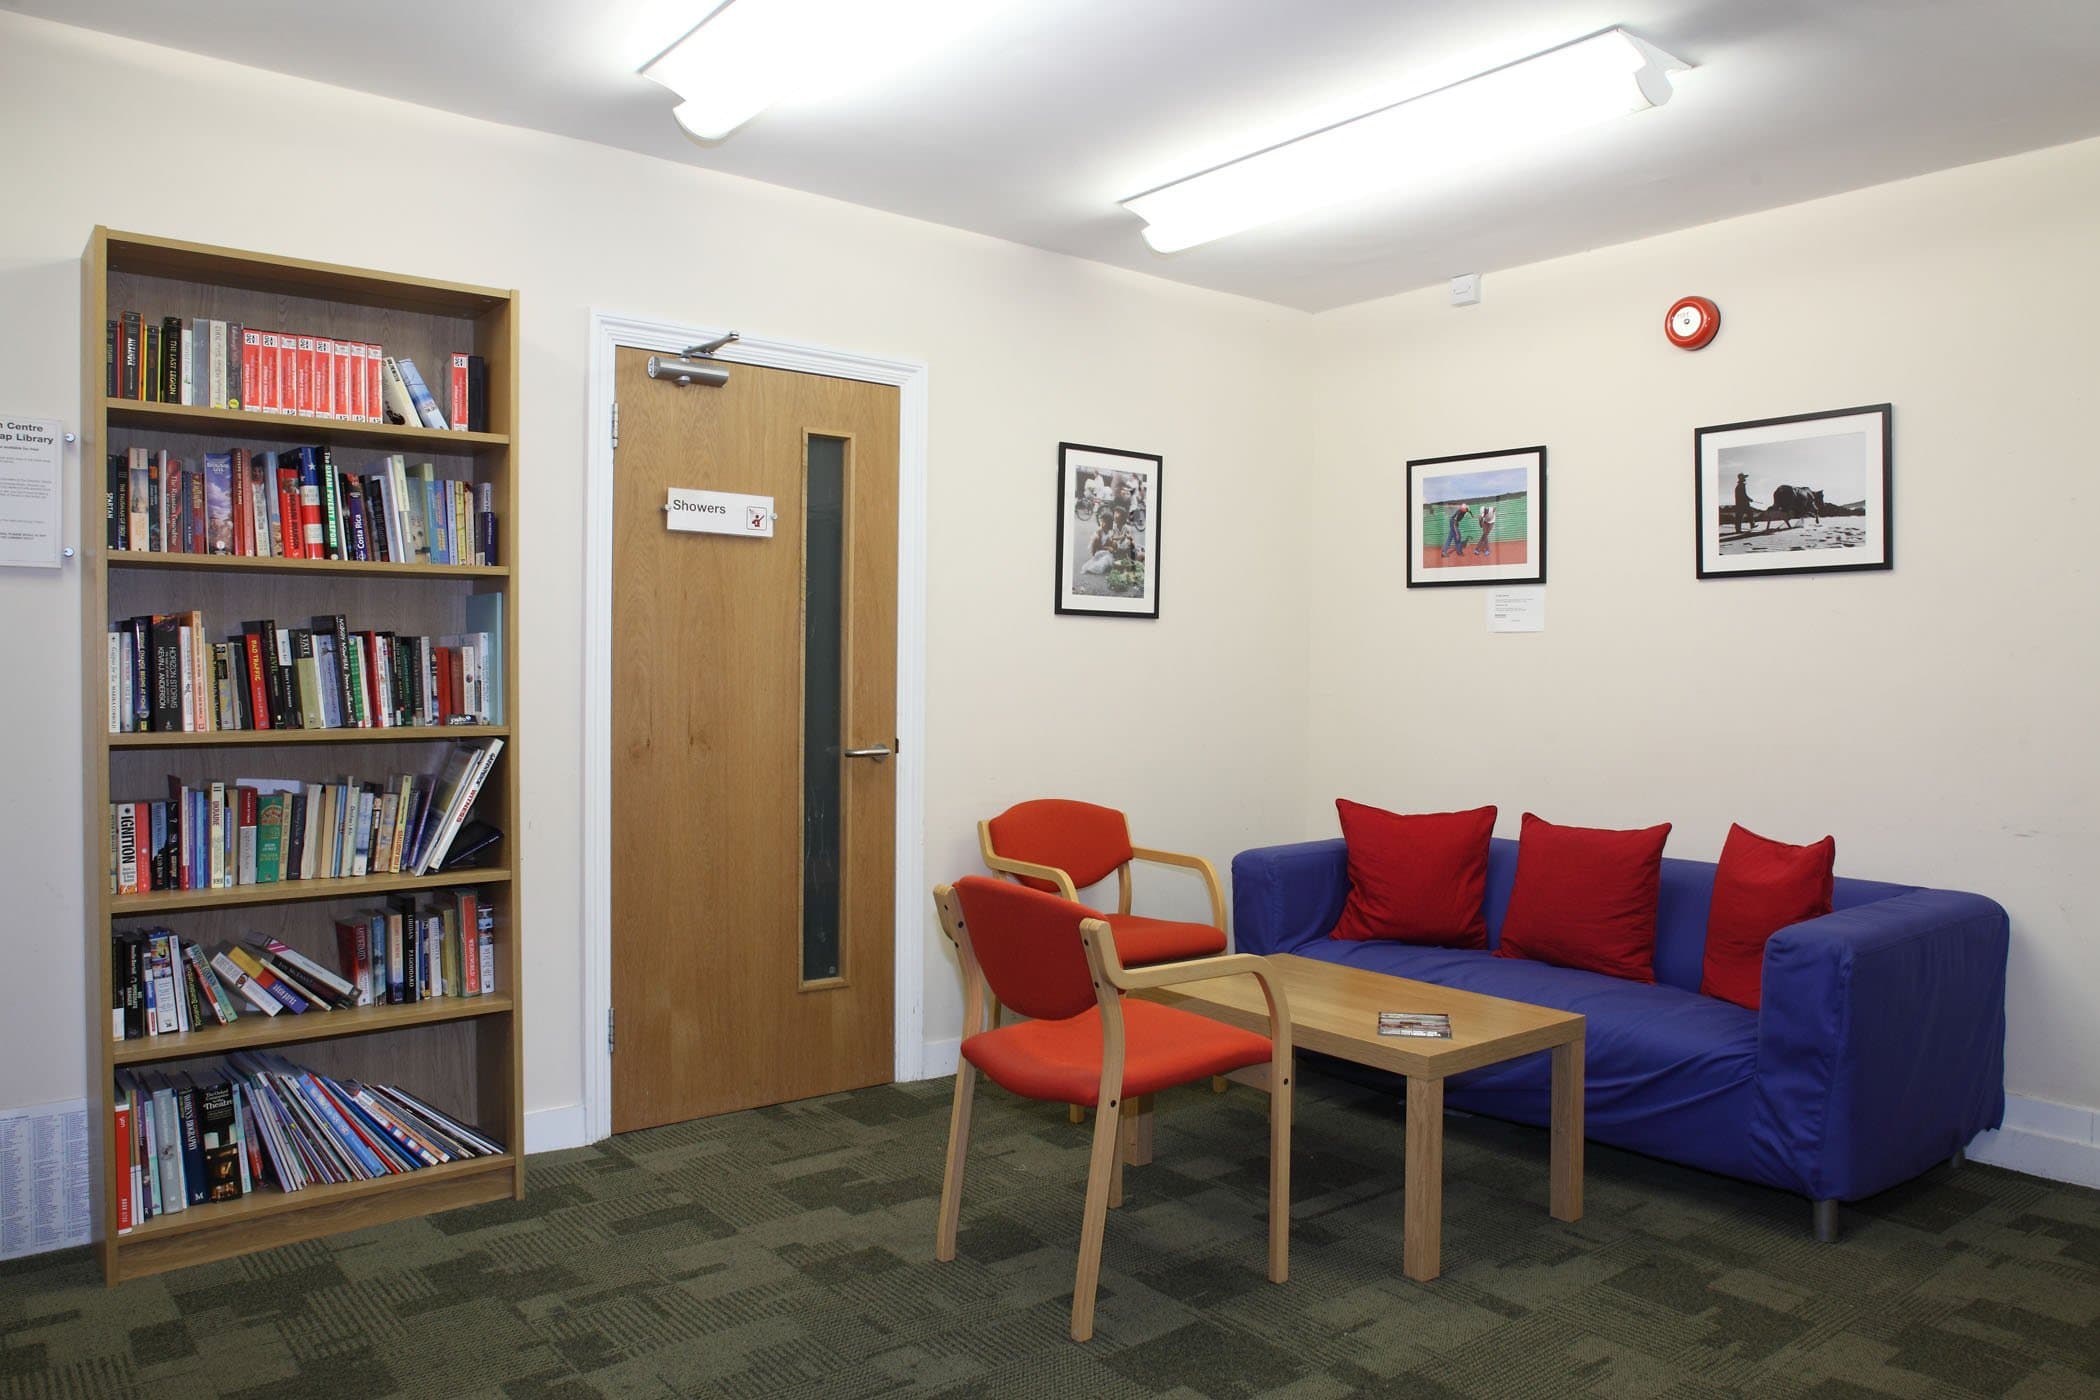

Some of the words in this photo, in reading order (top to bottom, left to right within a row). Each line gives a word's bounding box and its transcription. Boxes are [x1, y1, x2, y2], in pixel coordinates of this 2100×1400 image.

[170, 370, 178, 395] LEGION
[7, 422, 44, 432] Centre
[16, 433, 54, 445] Library
[326, 464, 334, 488] OXFAM
[170, 488, 179, 512] Russian
[326, 489, 336, 518] POVERTY
[673, 499, 726, 514] Showers
[328, 520, 338, 546] REPORT
[354, 514, 364, 529] Rica
[355, 530, 366, 550] Costa
[168, 646, 177, 678] HORIZON
[170, 680, 178, 708] STORMS
[456, 790, 478, 823] WITNESS
[121, 816, 136, 864] IGNITION
[186, 1120, 198, 1152] BIOGRAPHY
